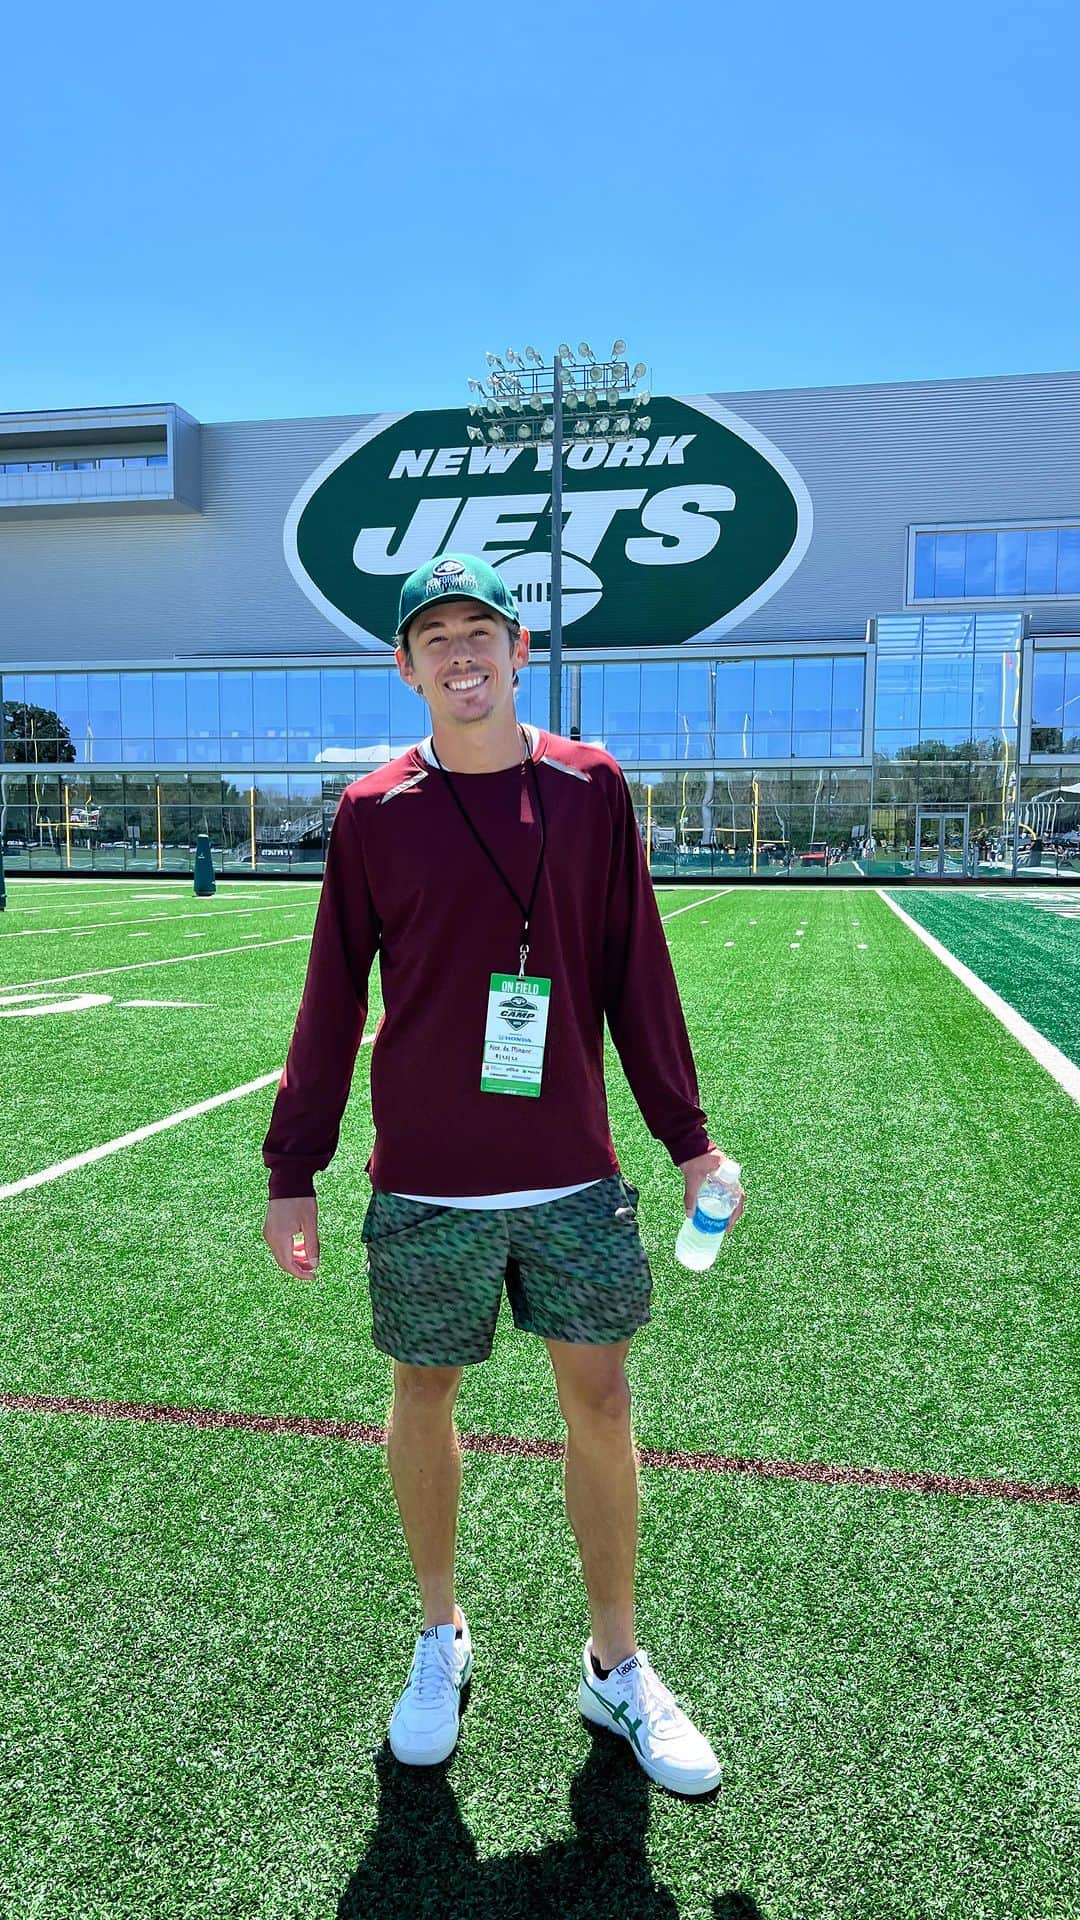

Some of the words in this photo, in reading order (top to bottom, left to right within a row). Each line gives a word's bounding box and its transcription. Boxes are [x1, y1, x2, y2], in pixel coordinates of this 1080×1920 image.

[388, 446, 523, 479] NEW
[533, 434, 697, 473] YORK
[352, 484, 737, 576] JETS
[501, 980, 514, 992] ON
[515, 982, 539, 995] FIELD
[500, 1010, 536, 1019] CAMP
